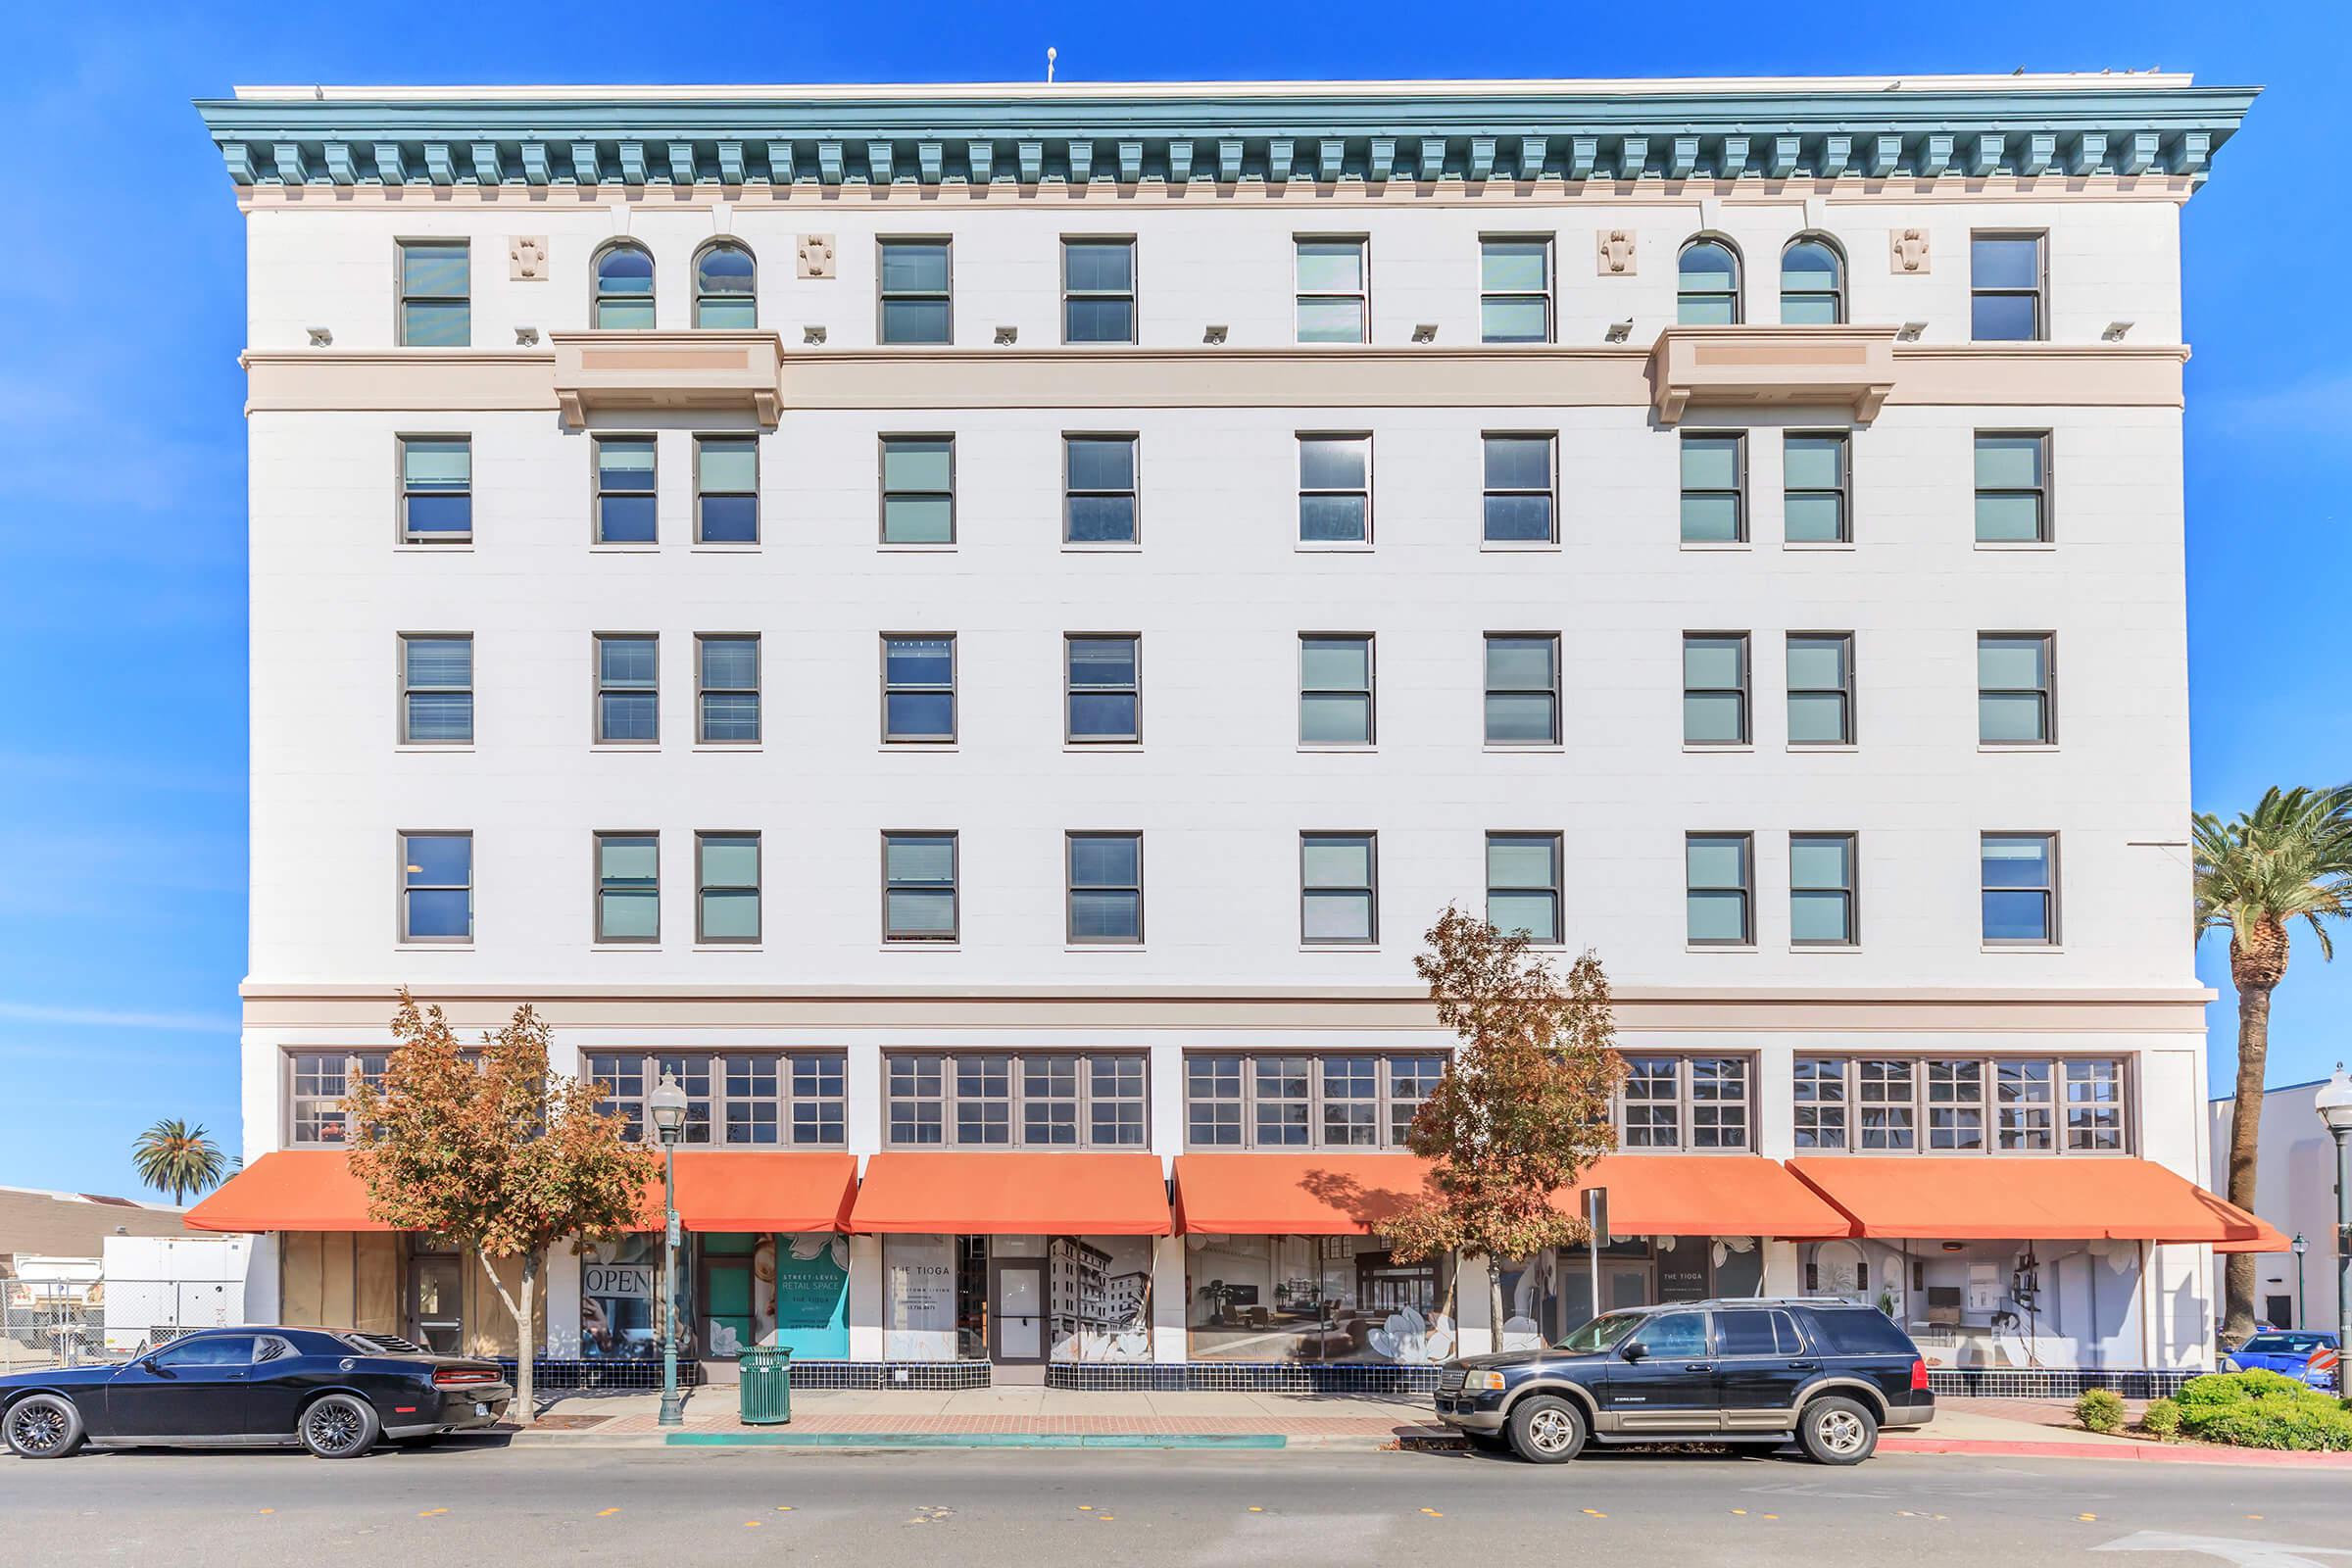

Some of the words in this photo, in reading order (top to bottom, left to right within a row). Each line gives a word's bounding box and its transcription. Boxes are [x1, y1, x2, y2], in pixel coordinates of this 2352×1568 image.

[917, 1266, 950, 1276] TIOGA
[587, 1269, 651, 1293] OPEN
[783, 1282, 809, 1291] RETAIL
[812, 1282, 840, 1291] SPACE
